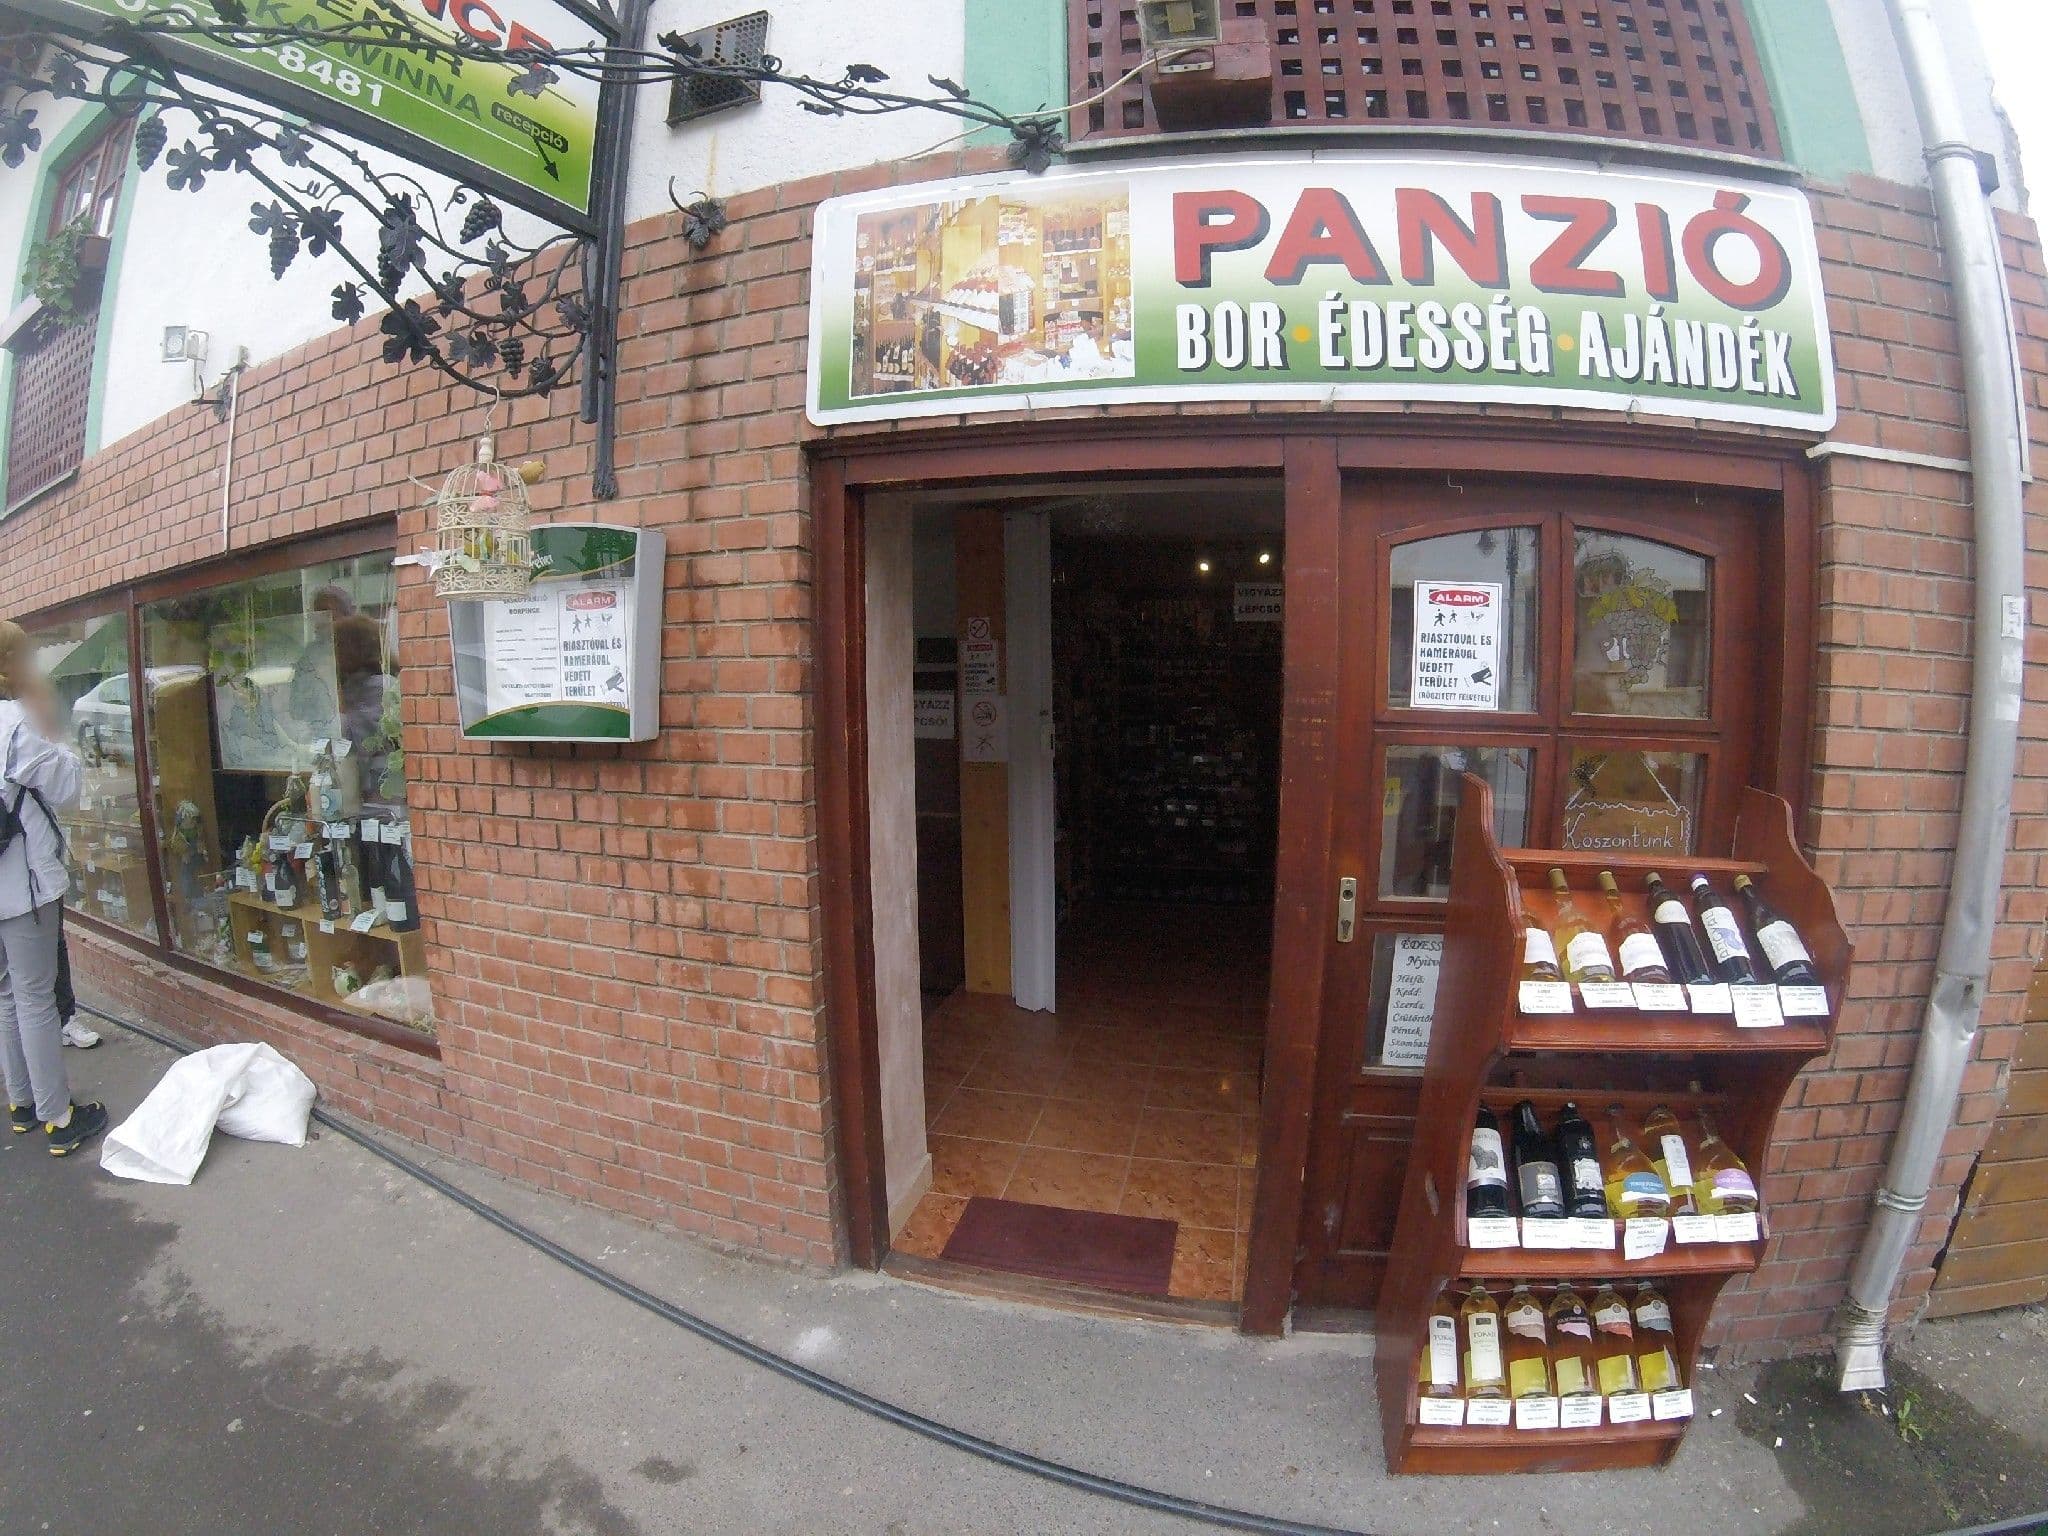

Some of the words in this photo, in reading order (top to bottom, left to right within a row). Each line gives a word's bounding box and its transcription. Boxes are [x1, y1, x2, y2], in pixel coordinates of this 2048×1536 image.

[496, 106, 564, 148] recepció
[1173, 187, 1792, 312] PANZIÓ
[1177, 300, 1290, 373] BOR
[1318, 290, 1555, 377] ÉDESSÉG
[1578, 303, 1801, 400] AJÁNDÉK
[572, 596, 611, 607] ALARM
[1436, 593, 1484, 603] ALARM
